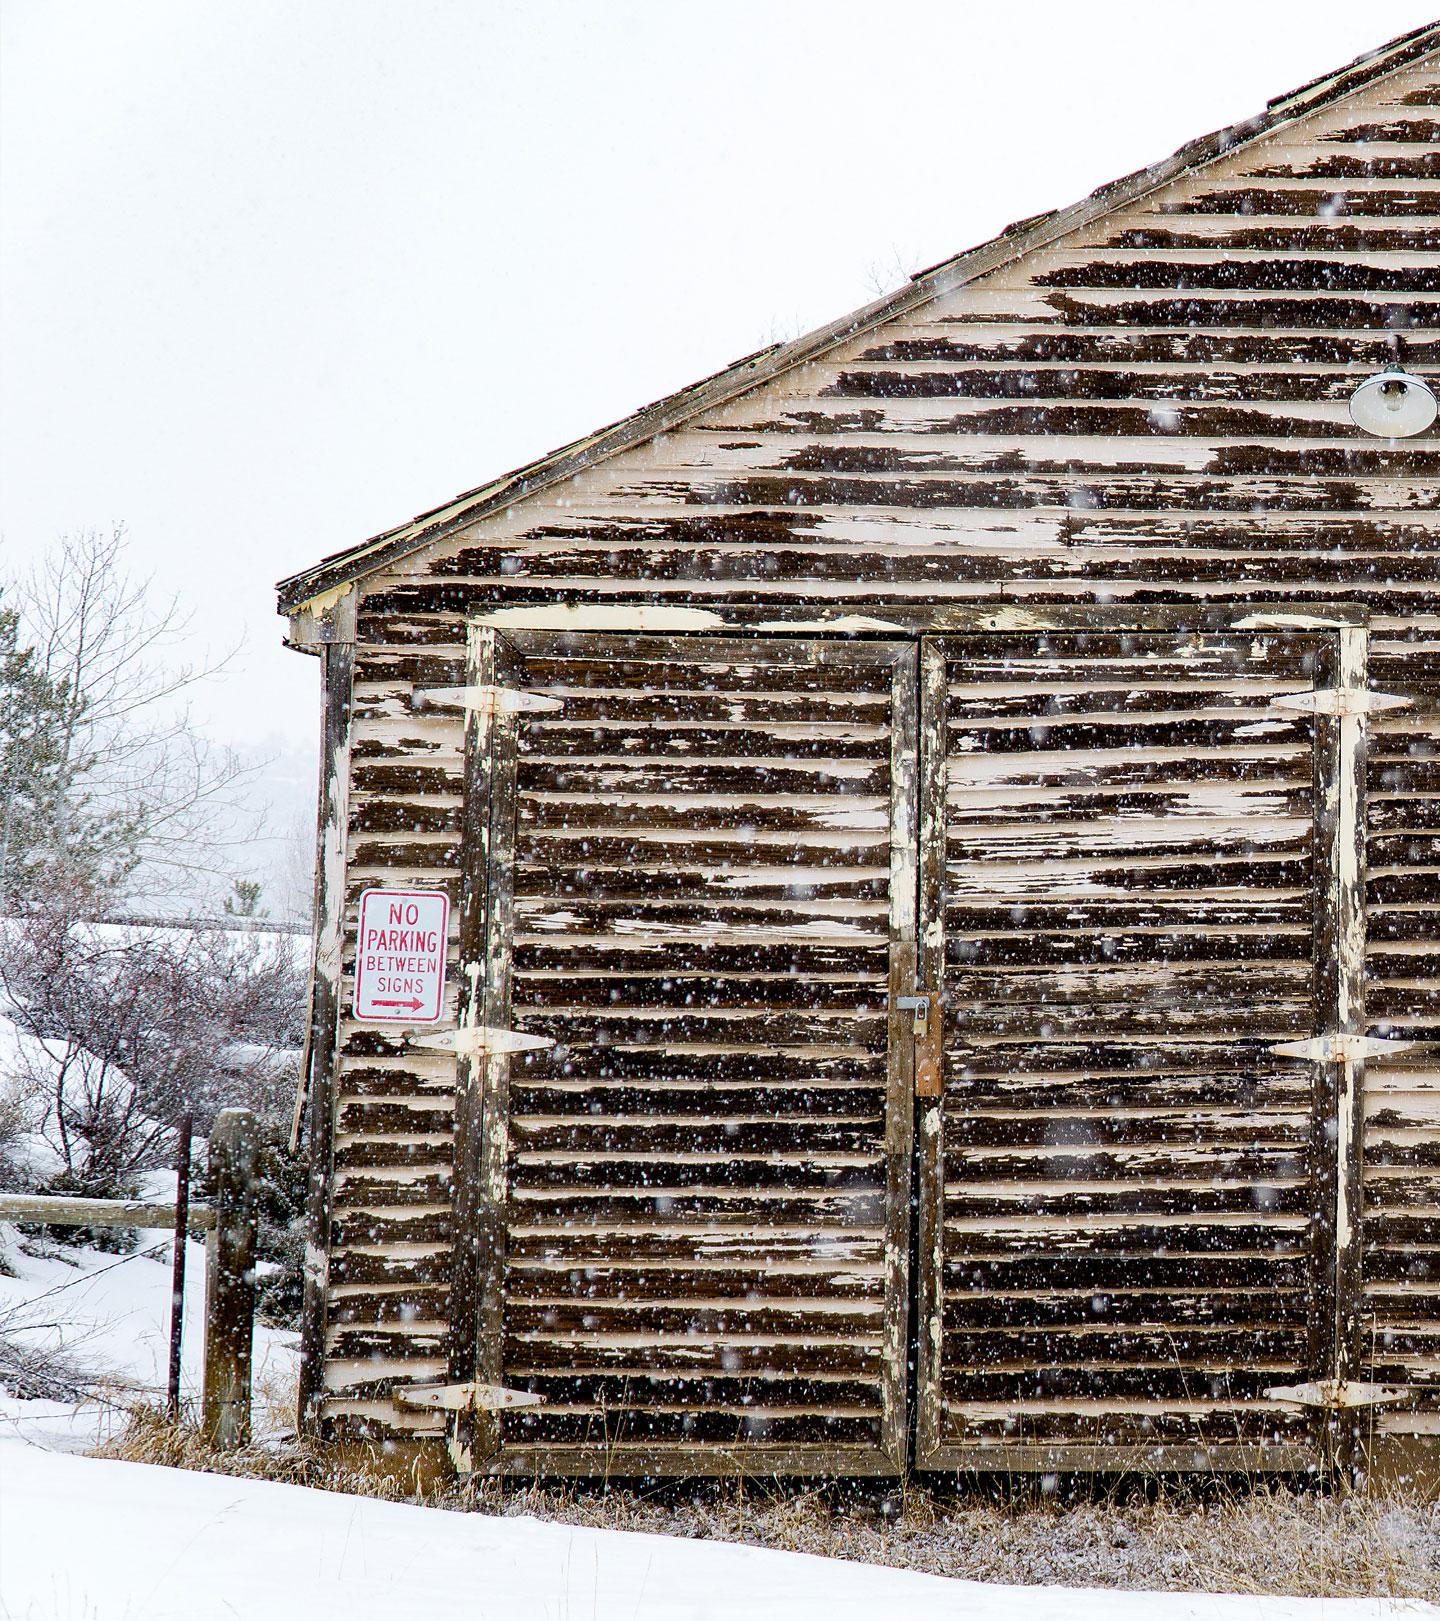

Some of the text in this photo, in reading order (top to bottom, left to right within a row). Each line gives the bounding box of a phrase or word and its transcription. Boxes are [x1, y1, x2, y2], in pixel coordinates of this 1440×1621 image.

[389, 903, 419, 925] NO
[367, 929, 437, 952] PARKING
[366, 956, 436, 973] BETWEEN
[377, 977, 424, 993] SIGNS
